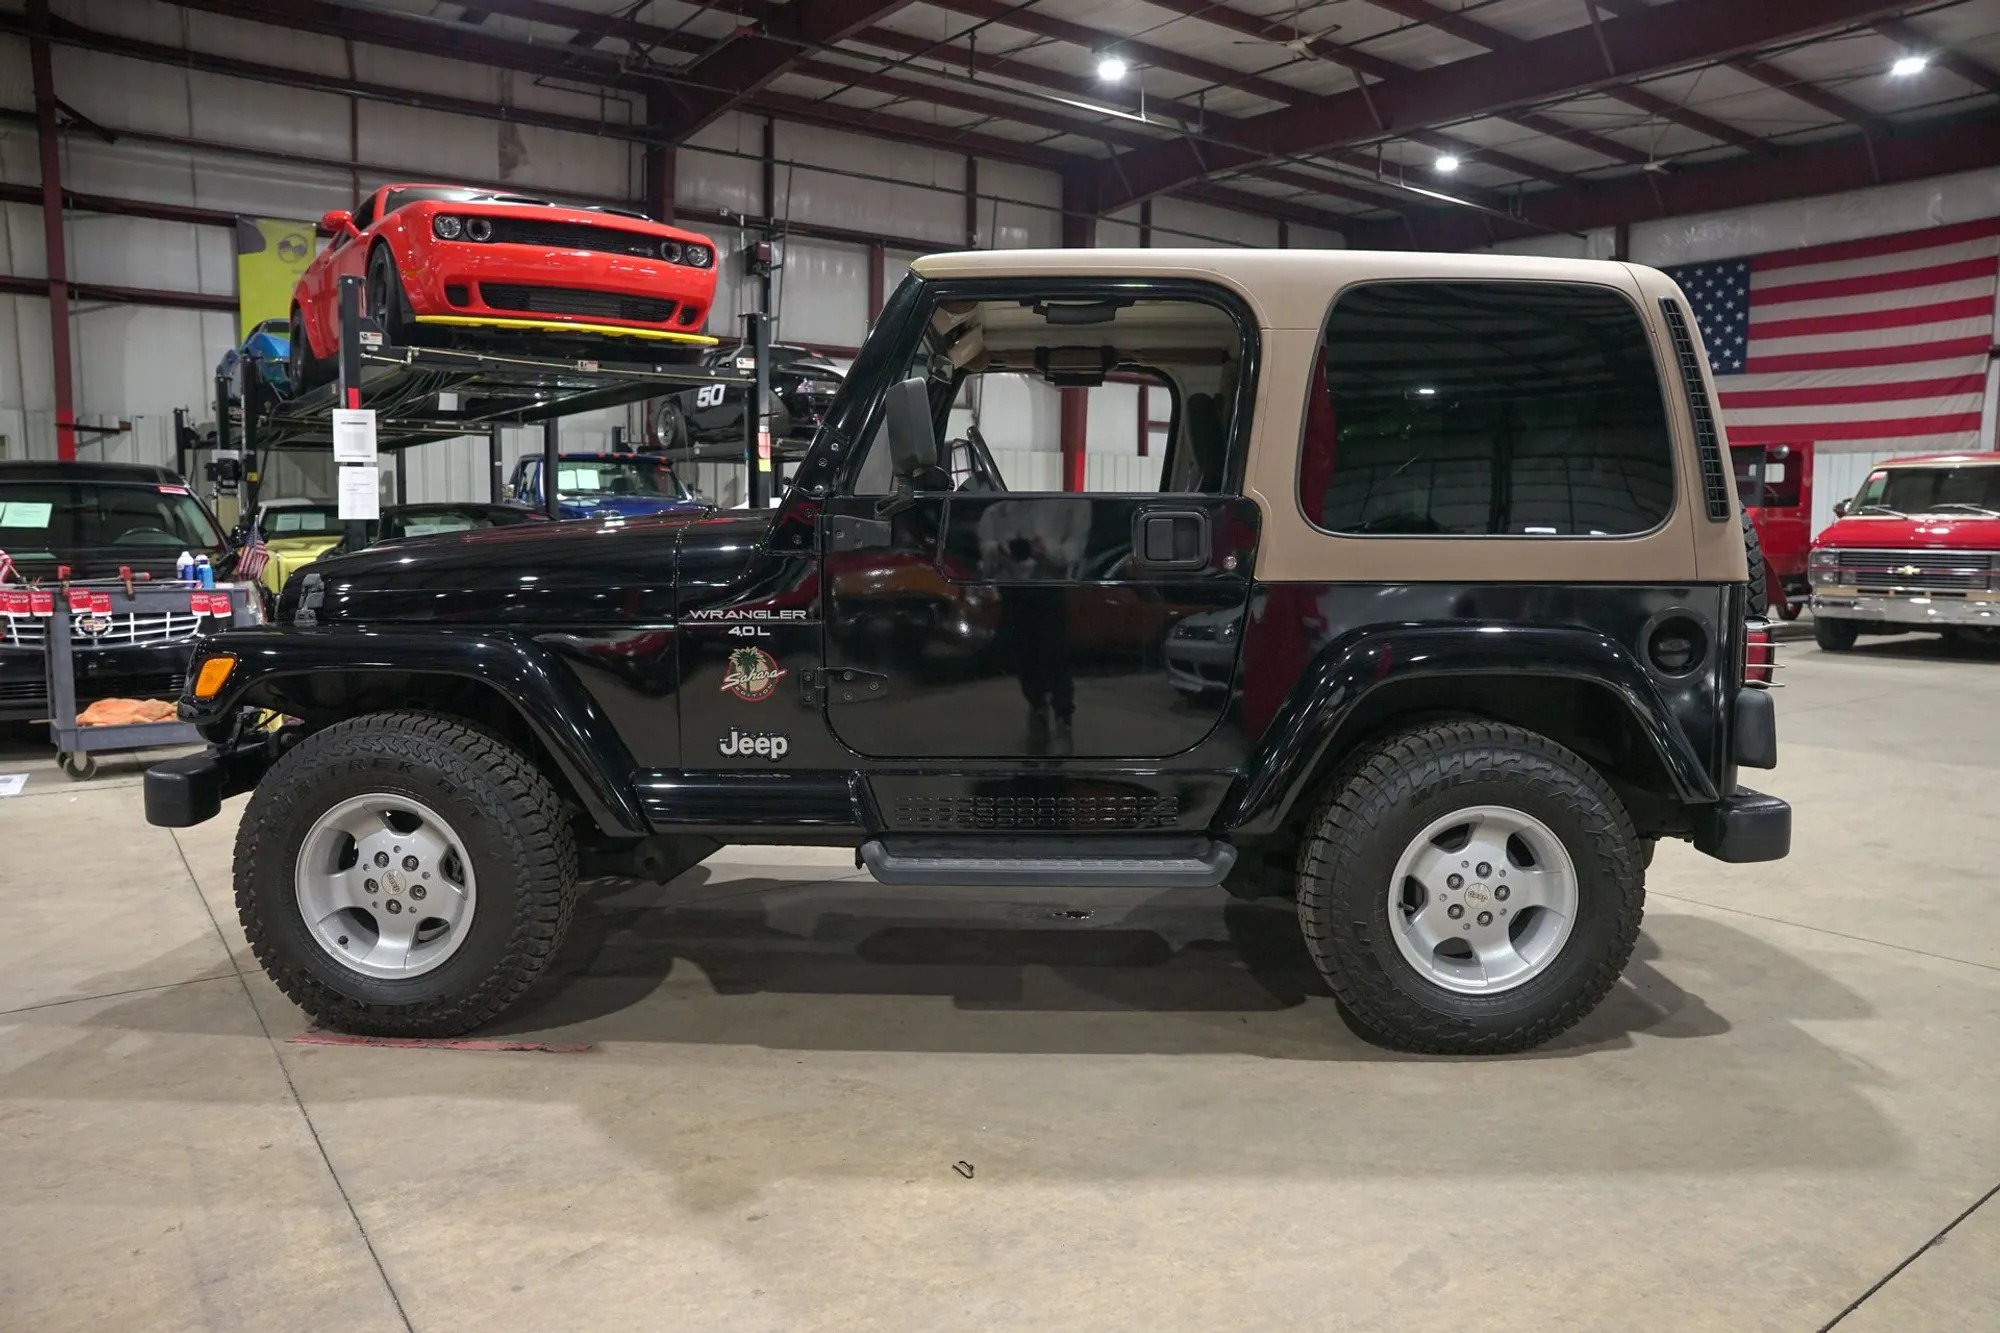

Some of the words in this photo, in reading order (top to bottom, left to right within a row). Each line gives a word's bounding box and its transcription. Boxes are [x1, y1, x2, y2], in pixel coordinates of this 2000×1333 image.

[697, 384, 726, 408] 50
[690, 610, 807, 620] WRANGLER
[720, 669, 788, 692] Sahara
[735, 683, 773, 698] EDITION
[720, 730, 788, 759] Jeep
